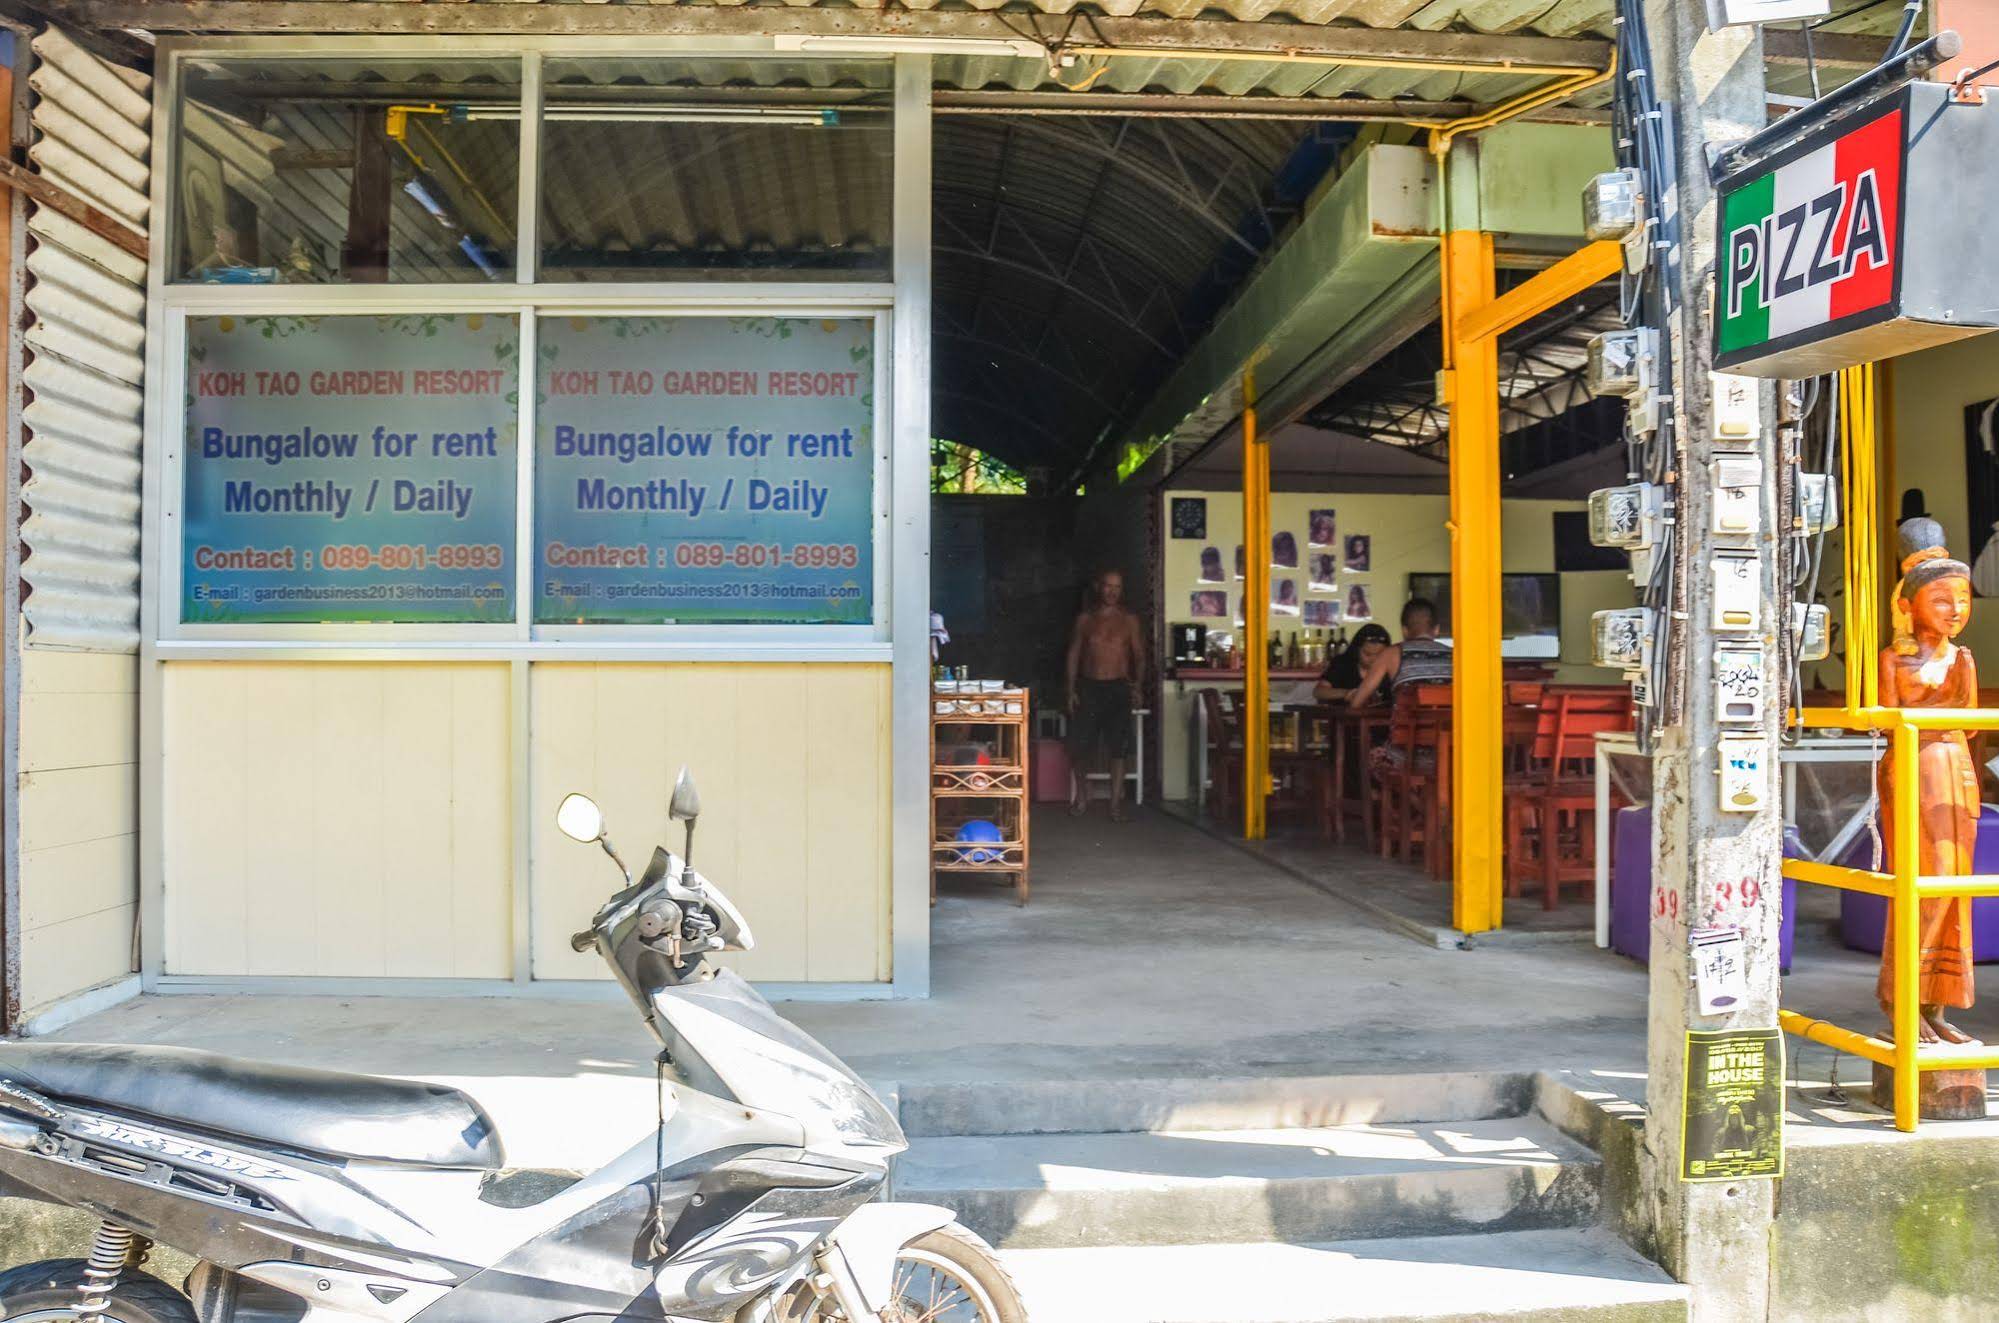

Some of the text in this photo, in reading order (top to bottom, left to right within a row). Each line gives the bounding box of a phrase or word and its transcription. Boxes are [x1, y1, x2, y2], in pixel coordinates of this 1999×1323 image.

[1727, 168, 1889, 319] PIZZA
[199, 369, 504, 397] KOH TAO GARDEN RESORT
[551, 371, 859, 397] KOH TAO GARDEN RESORT
[202, 426, 498, 465] Bungalow for rent
[554, 425, 853, 464] Bungalow for rent
[224, 479, 473, 519] Monthly / Daily
[577, 478, 829, 518] Monthly / Daily
[195, 546, 294, 570] Contact
[320, 545, 503, 569] 089-801-8993
[546, 543, 647, 568] Contact
[675, 544, 858, 568] 089-801-8993
[194, 586, 239, 600] E-mail
[254, 585, 505, 602] gardenbusiness2013@hotmail.com
[544, 583, 591, 598] E-mail
[606, 583, 861, 600] gardenbusiness2013@hotmail.com
[1714, 876, 1760, 912] 39
[1708, 1052, 1765, 1071] IN THE
[1707, 1067, 1765, 1086] HOUSE
